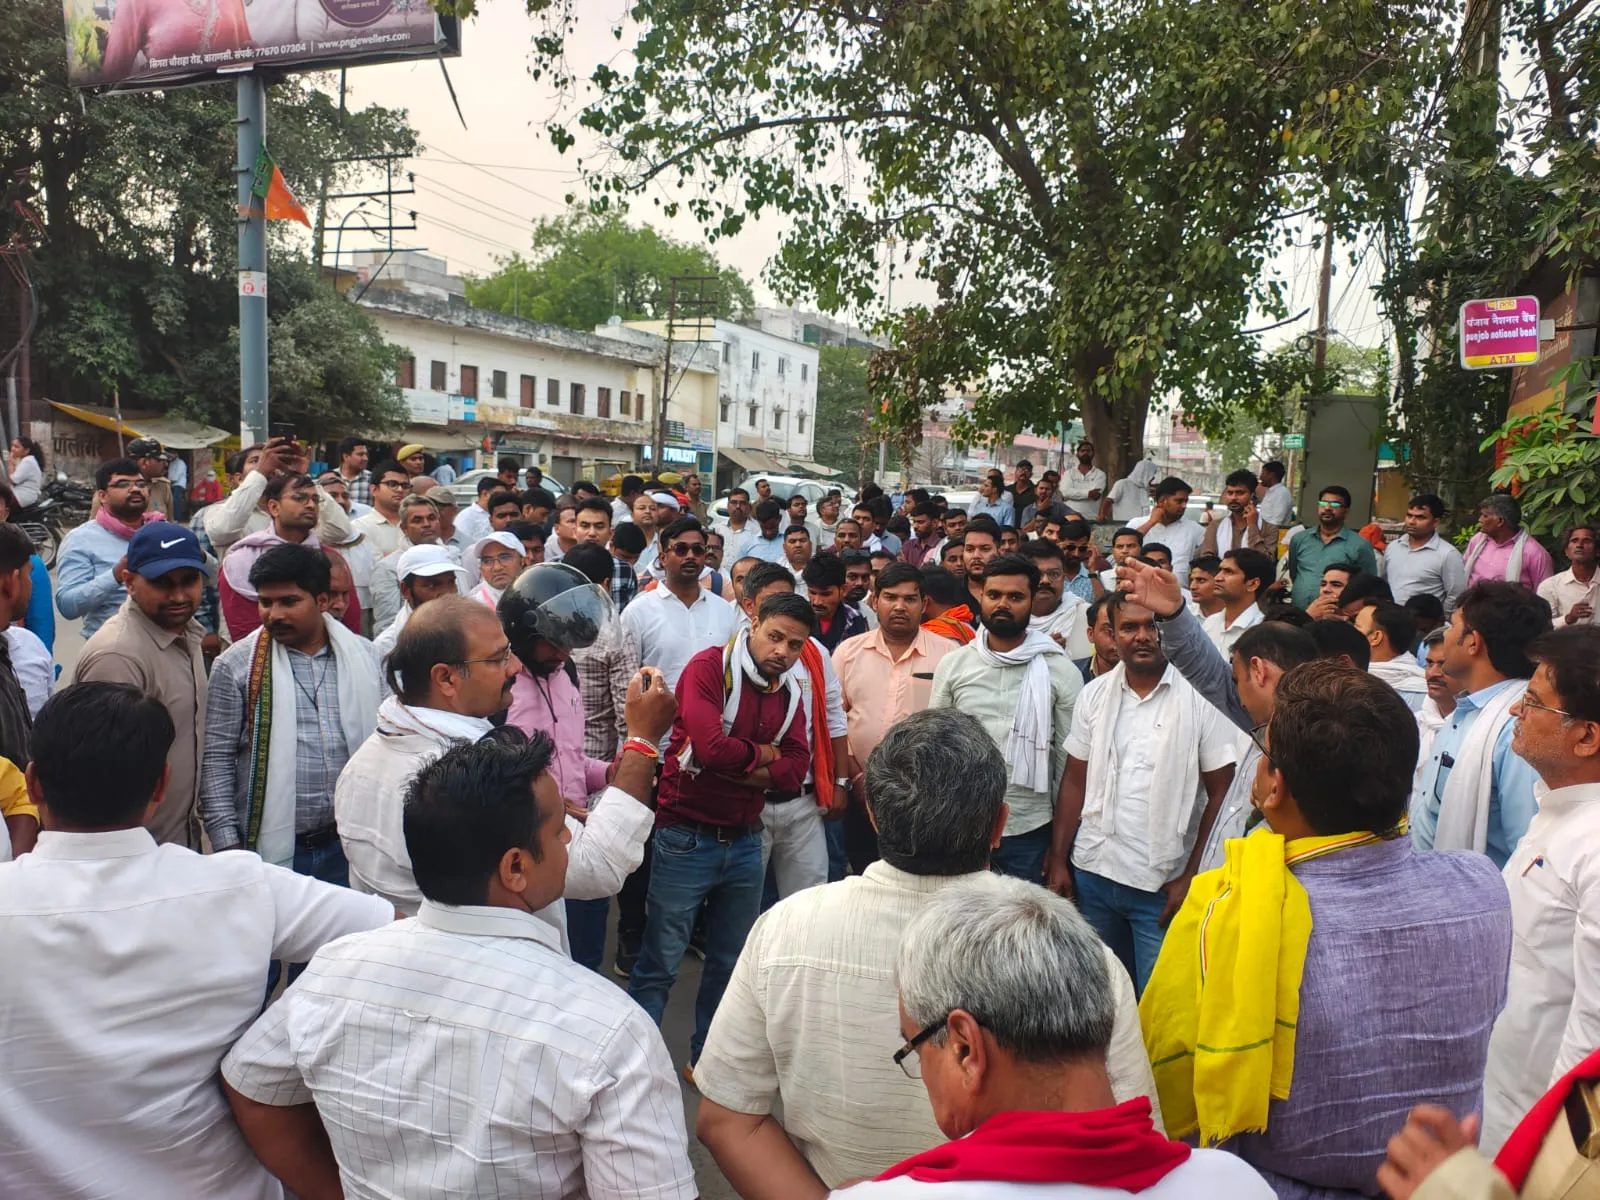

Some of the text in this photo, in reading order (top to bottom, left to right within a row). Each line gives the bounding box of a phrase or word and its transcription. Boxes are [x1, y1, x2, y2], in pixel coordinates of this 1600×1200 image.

[255, 32, 411, 57] 77670 07304 www.pngjewellers.com
[1466, 326, 1537, 344] punjab national bank
[1490, 355, 1516, 365] ATM
